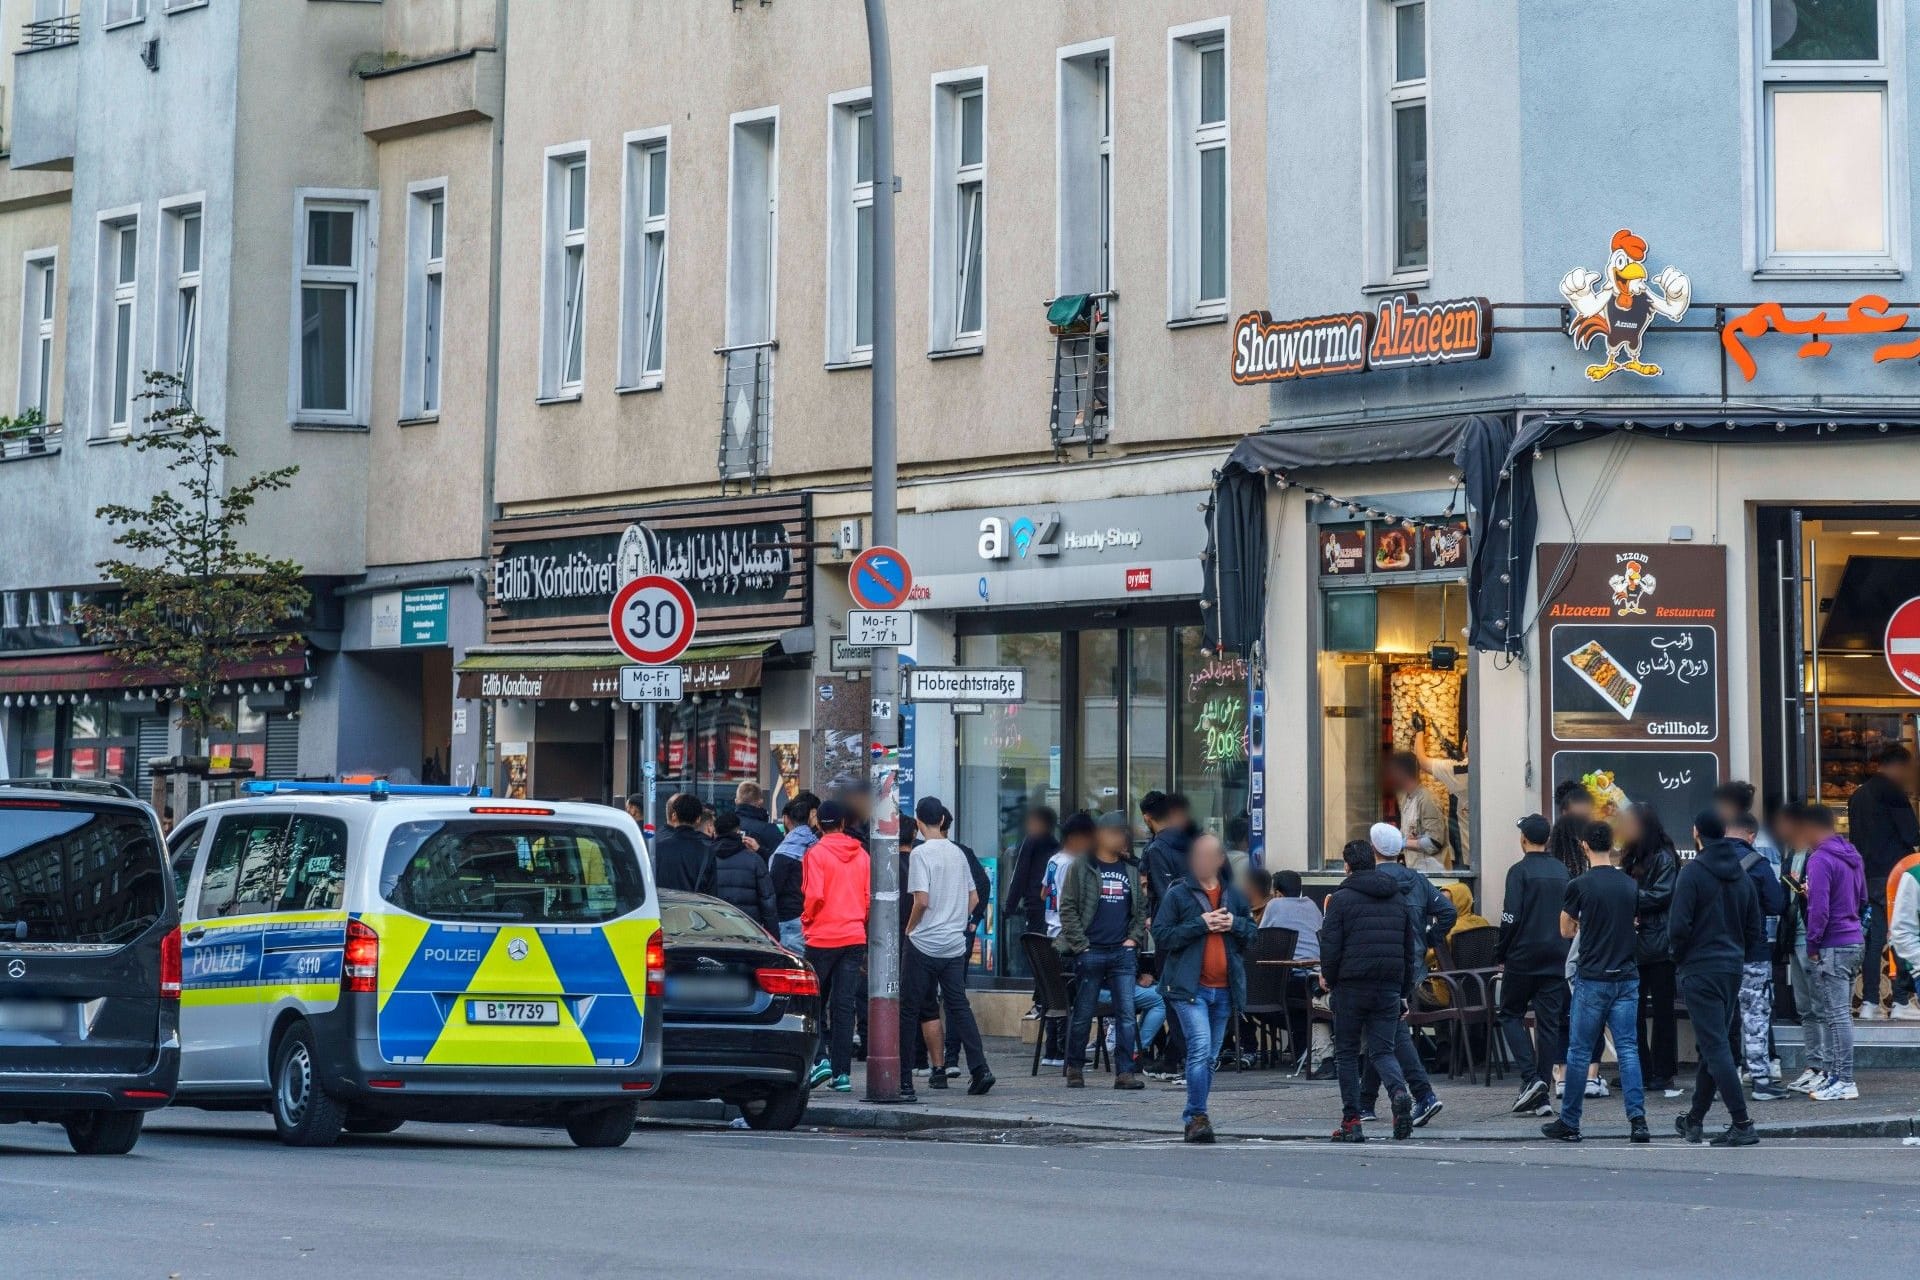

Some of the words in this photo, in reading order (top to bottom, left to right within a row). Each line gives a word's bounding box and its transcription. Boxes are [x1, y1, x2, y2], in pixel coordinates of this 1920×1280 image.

[1235, 322, 1362, 375] Shawarma
[1372, 304, 1477, 358] Alzaeem
[1616, 552, 1649, 564] Azzam
[494, 556, 530, 601] Edlib
[535, 552, 613, 598] Konditorei
[1550, 603, 1611, 617] Alzaeem
[1655, 606, 1716, 618] Restaurant
[629, 600, 677, 639] 30
[862, 615, 898, 626] Mo-Fr
[891, 630, 897, 642] h
[481, 673, 501, 696] Edlib
[501, 672, 543, 696] Konditorei
[633, 671, 670, 682] Mo-Fr
[917, 673, 1015, 695] Hobrechtstraße
[664, 686, 670, 697] h
[1647, 721, 1709, 735] Grillholz
[1207, 726, 1235, 759] 200
[191, 944, 246, 976] POLIZEI
[424, 948, 481, 963] POLIZEI
[305, 957, 321, 974] 110
[487, 1003, 498, 1019] B
[507, 1003, 545, 1020] 7739
